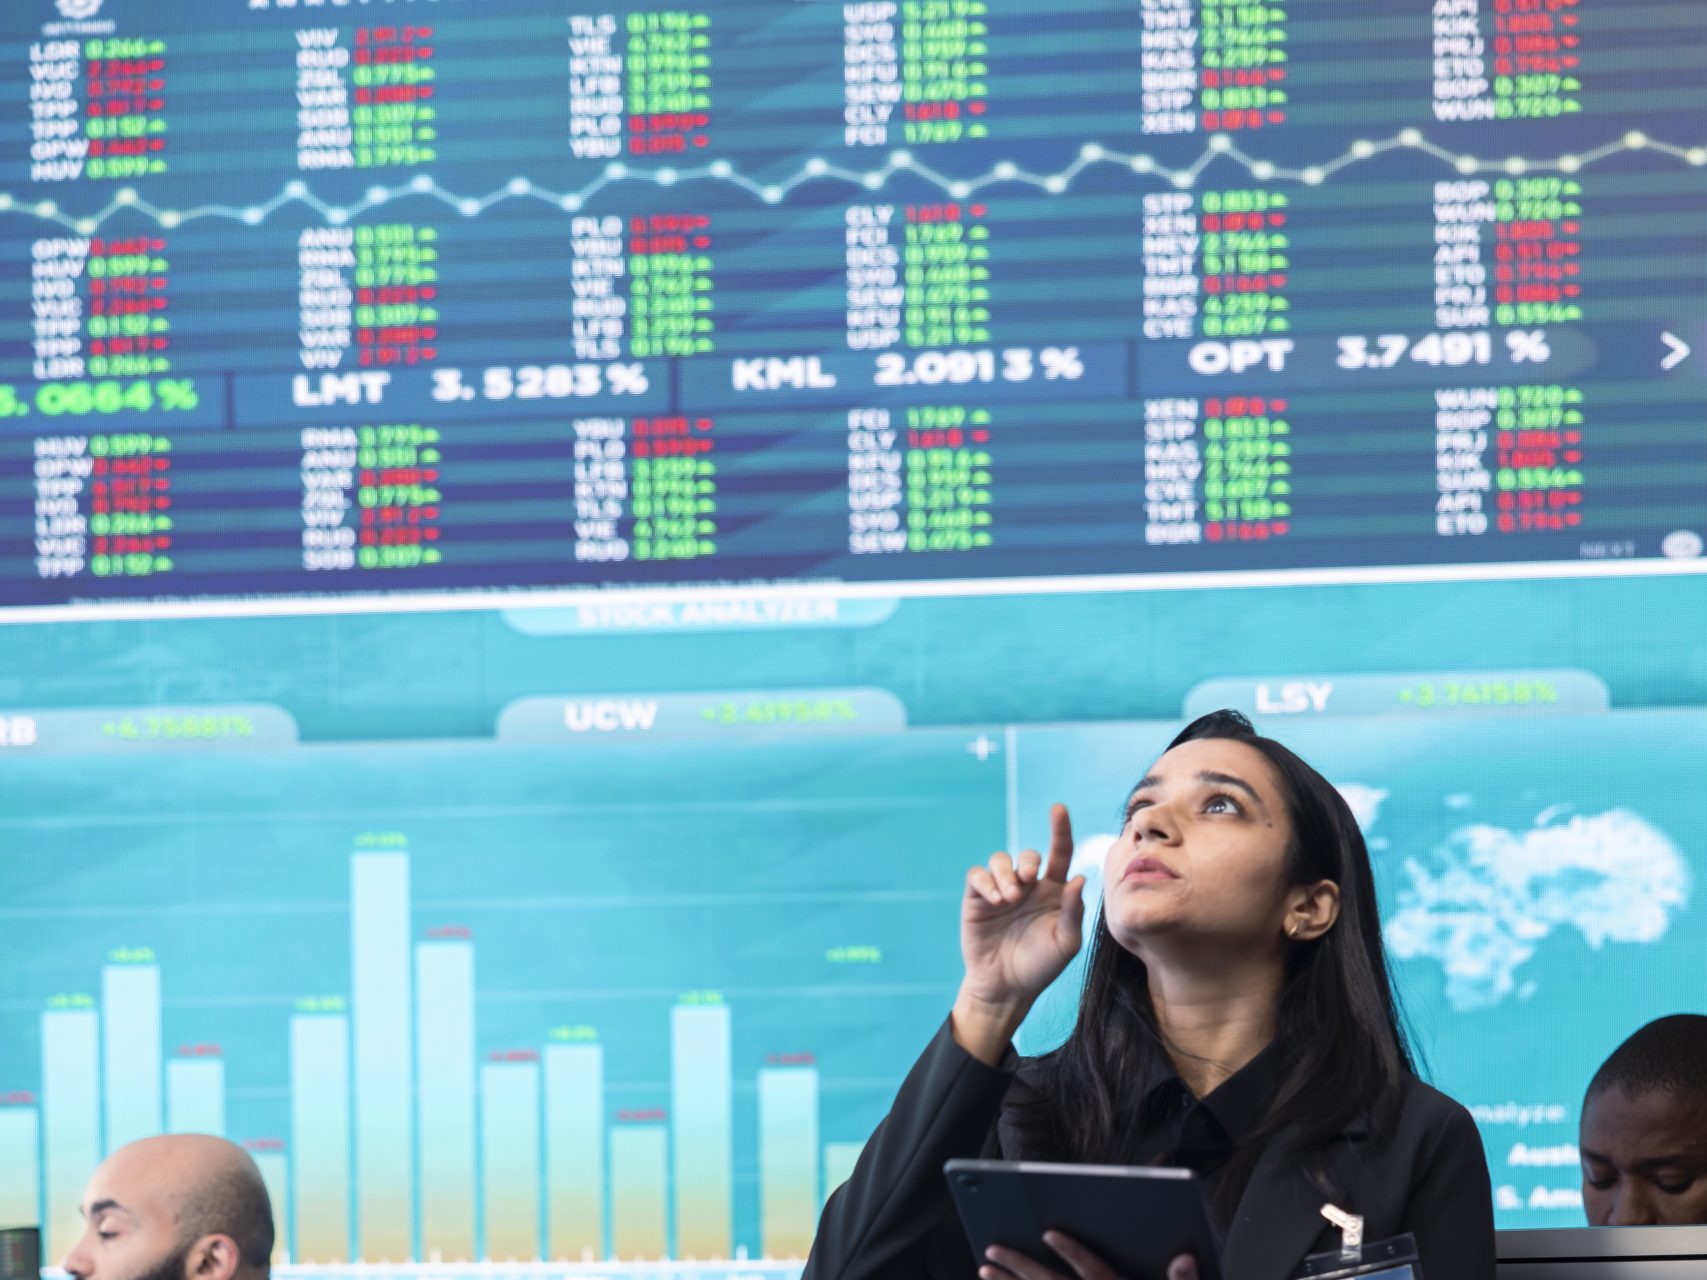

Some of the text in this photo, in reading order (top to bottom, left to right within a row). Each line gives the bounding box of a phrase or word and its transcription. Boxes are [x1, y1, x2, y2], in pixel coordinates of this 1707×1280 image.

[733, 356, 836, 390] KML
[1189, 339, 1294, 375] OPT
[292, 372, 390, 406] LMT
[1255, 682, 1333, 714] LSY
[563, 701, 658, 732] UCW
